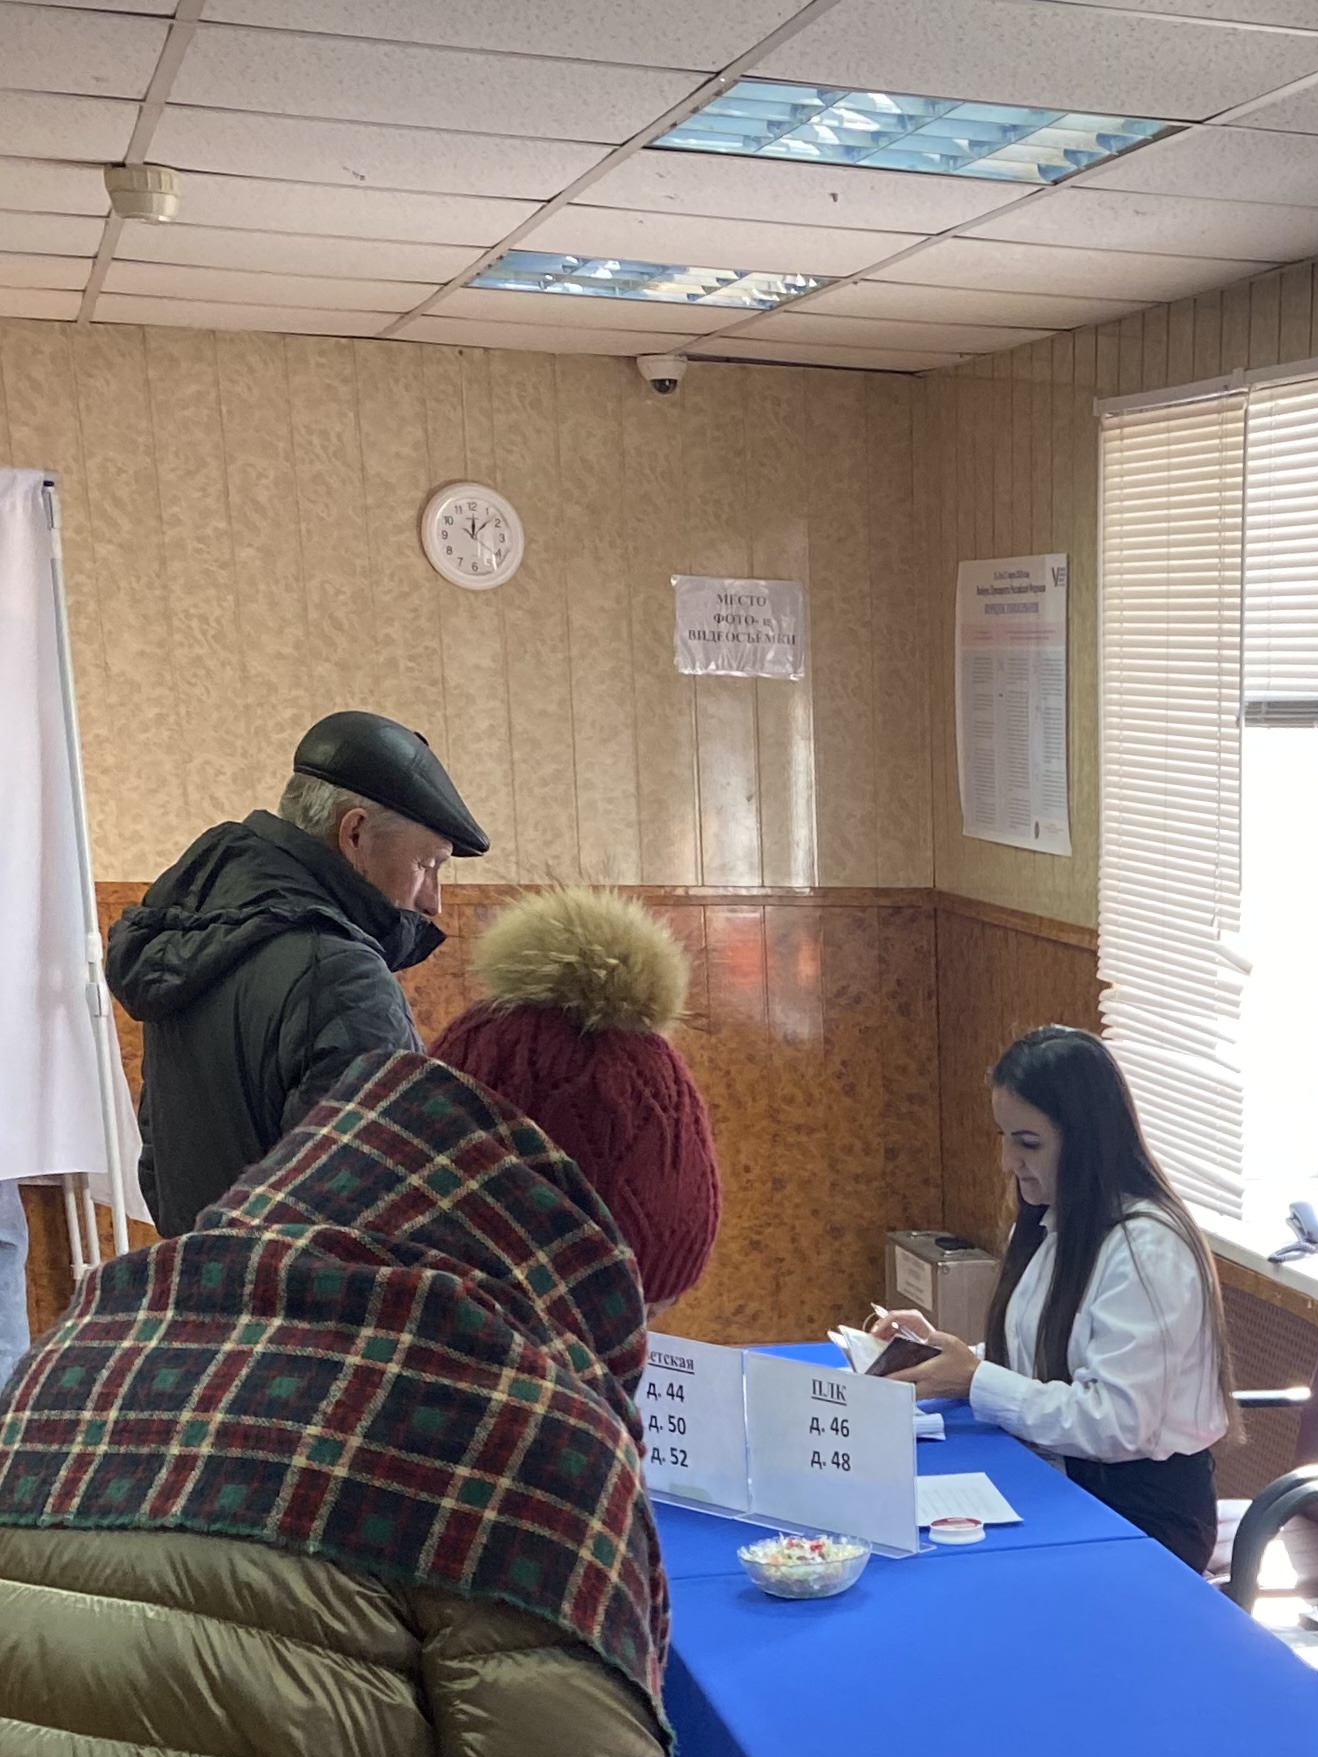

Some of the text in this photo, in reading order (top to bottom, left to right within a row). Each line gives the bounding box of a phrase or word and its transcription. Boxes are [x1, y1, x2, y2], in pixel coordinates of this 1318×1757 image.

[454, 505, 462, 514] 11
[466, 502, 477, 511] 12
[485, 507, 490, 515] 1
[444, 516, 454, 525] 10
[494, 518, 501, 528] 2
[441, 530, 448, 539] 9
[499, 533, 505, 543] 3
[446, 546, 453, 555] 8
[494, 548, 502, 558] 4
[457, 557, 464, 567] 7
[471, 562, 479, 572] 6
[717, 593, 767, 607] МЕСТО
[713, 613, 759, 626] ФОТО-
[647, 1350, 694, 1371] етская
[666, 1382, 685, 1402] 44
[811, 1378, 847, 1402] ПЛК
[668, 1414, 686, 1435] 50
[830, 1416, 850, 1438] 46
[670, 1446, 688, 1467] 52
[831, 1450, 851, 1471] 48
